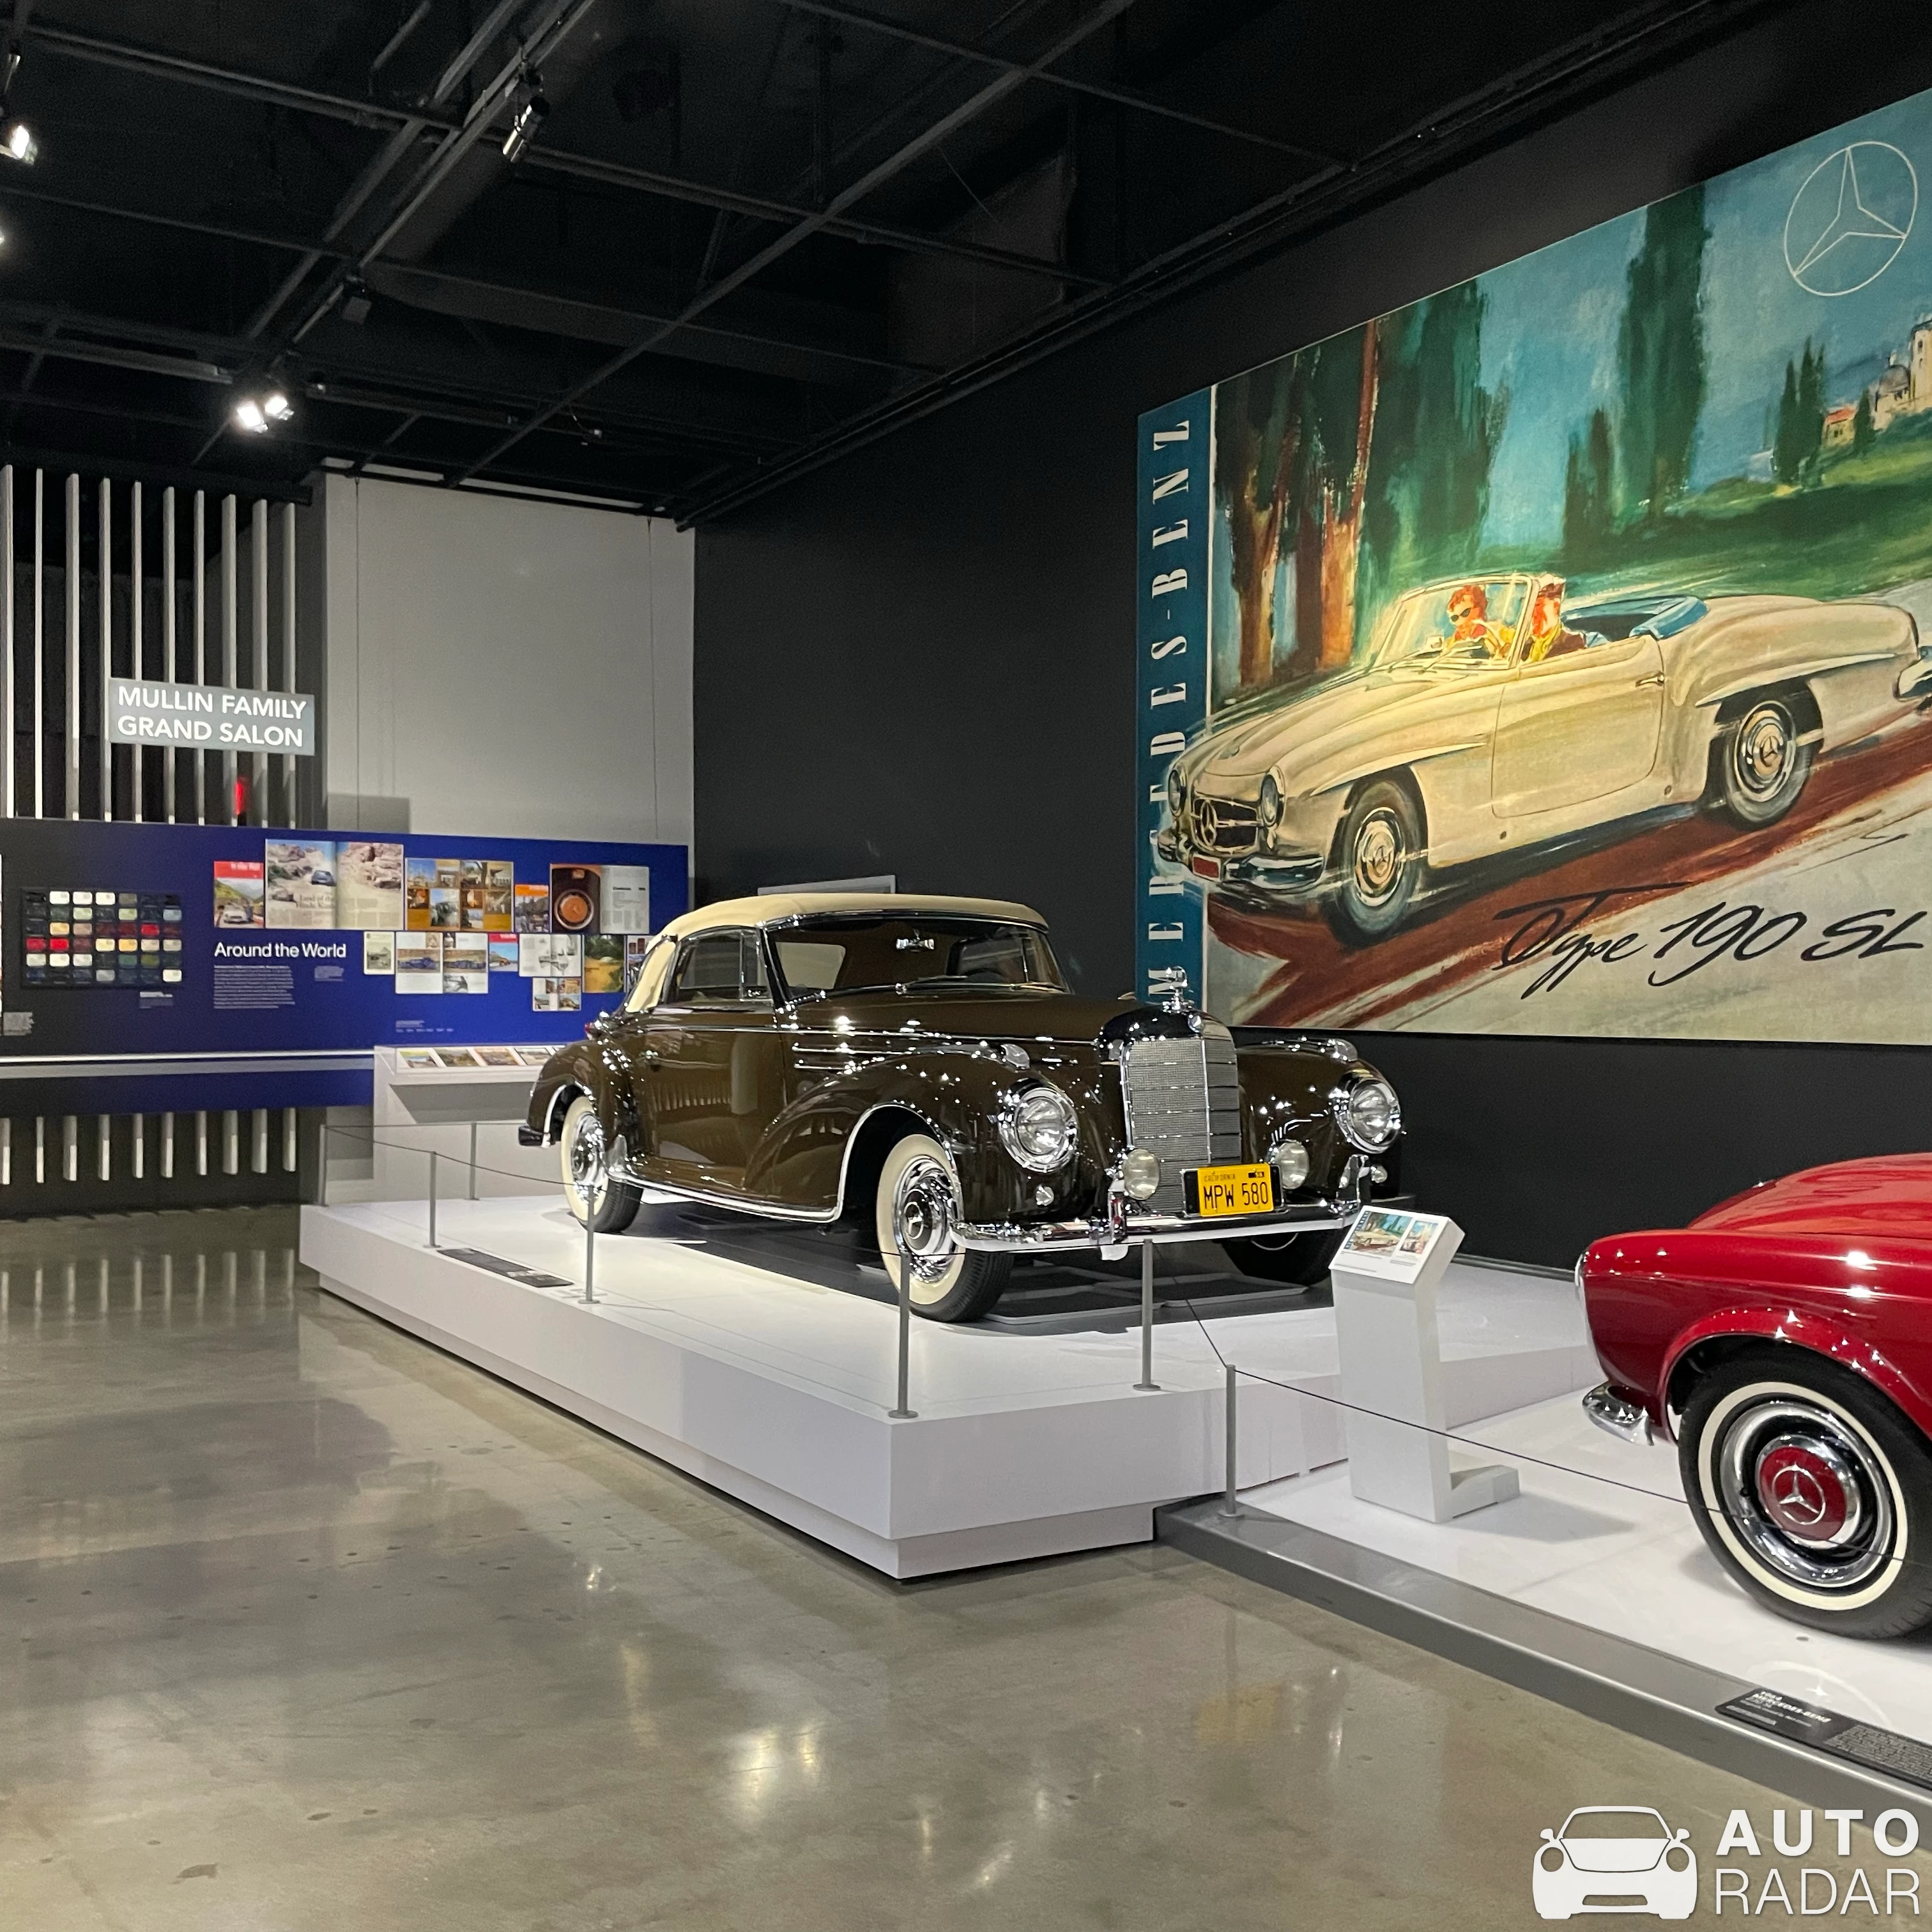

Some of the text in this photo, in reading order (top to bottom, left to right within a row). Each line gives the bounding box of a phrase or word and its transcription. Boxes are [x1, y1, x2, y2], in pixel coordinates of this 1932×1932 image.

[118, 686, 307, 719] MULLIN FAMILY
[118, 715, 303, 747] GRAND SALON
[214, 942, 346, 958] Around the World
[1492, 881, 1928, 1000] Type 190 SL
[1204, 1174, 1236, 1182] CALIFORNIA
[1203, 1181, 1269, 1210] MPW 580
